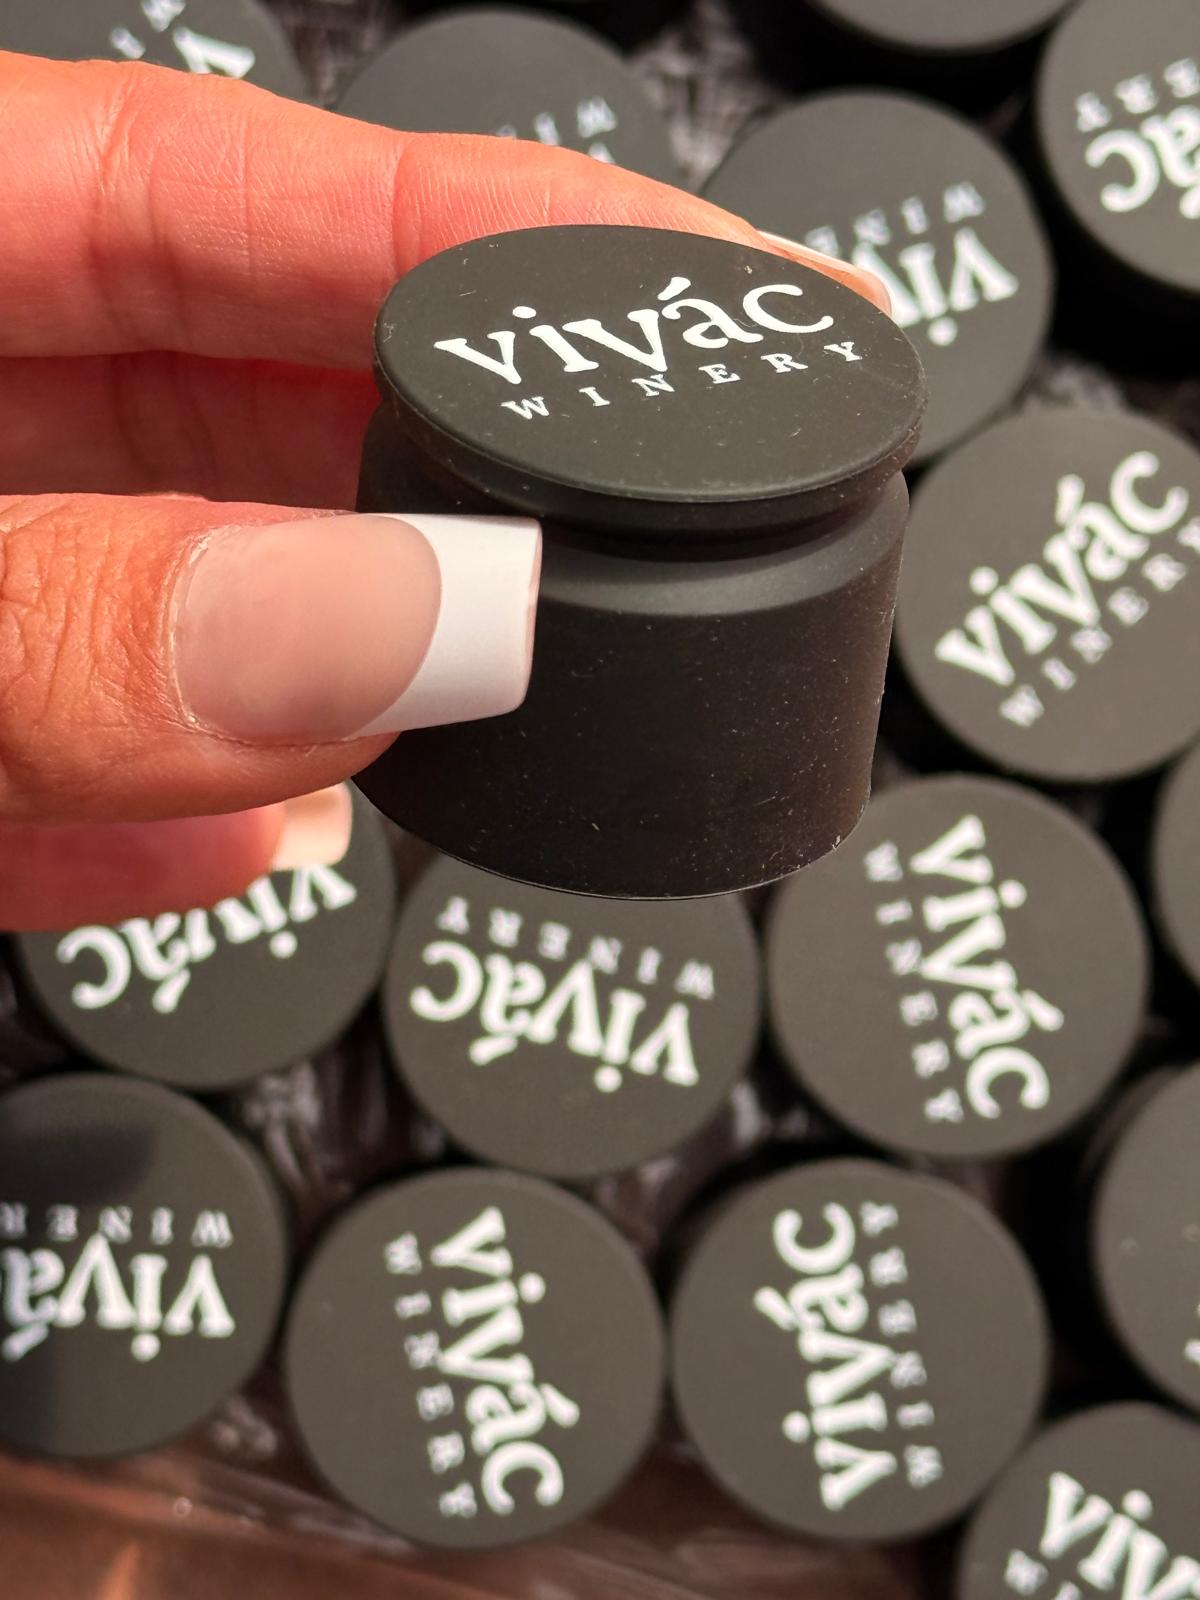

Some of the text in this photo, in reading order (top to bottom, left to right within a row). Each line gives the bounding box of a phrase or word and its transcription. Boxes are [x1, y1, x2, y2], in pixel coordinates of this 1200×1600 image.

[433, 276, 834, 385] vivác
[852, 226, 1019, 346] viv
[500, 341, 863, 420] WINERY
[0, 1202, 234, 1248] WINER
[0, 1234, 236, 1362] vivá
[1038, 1471, 1200, 1600] viv
